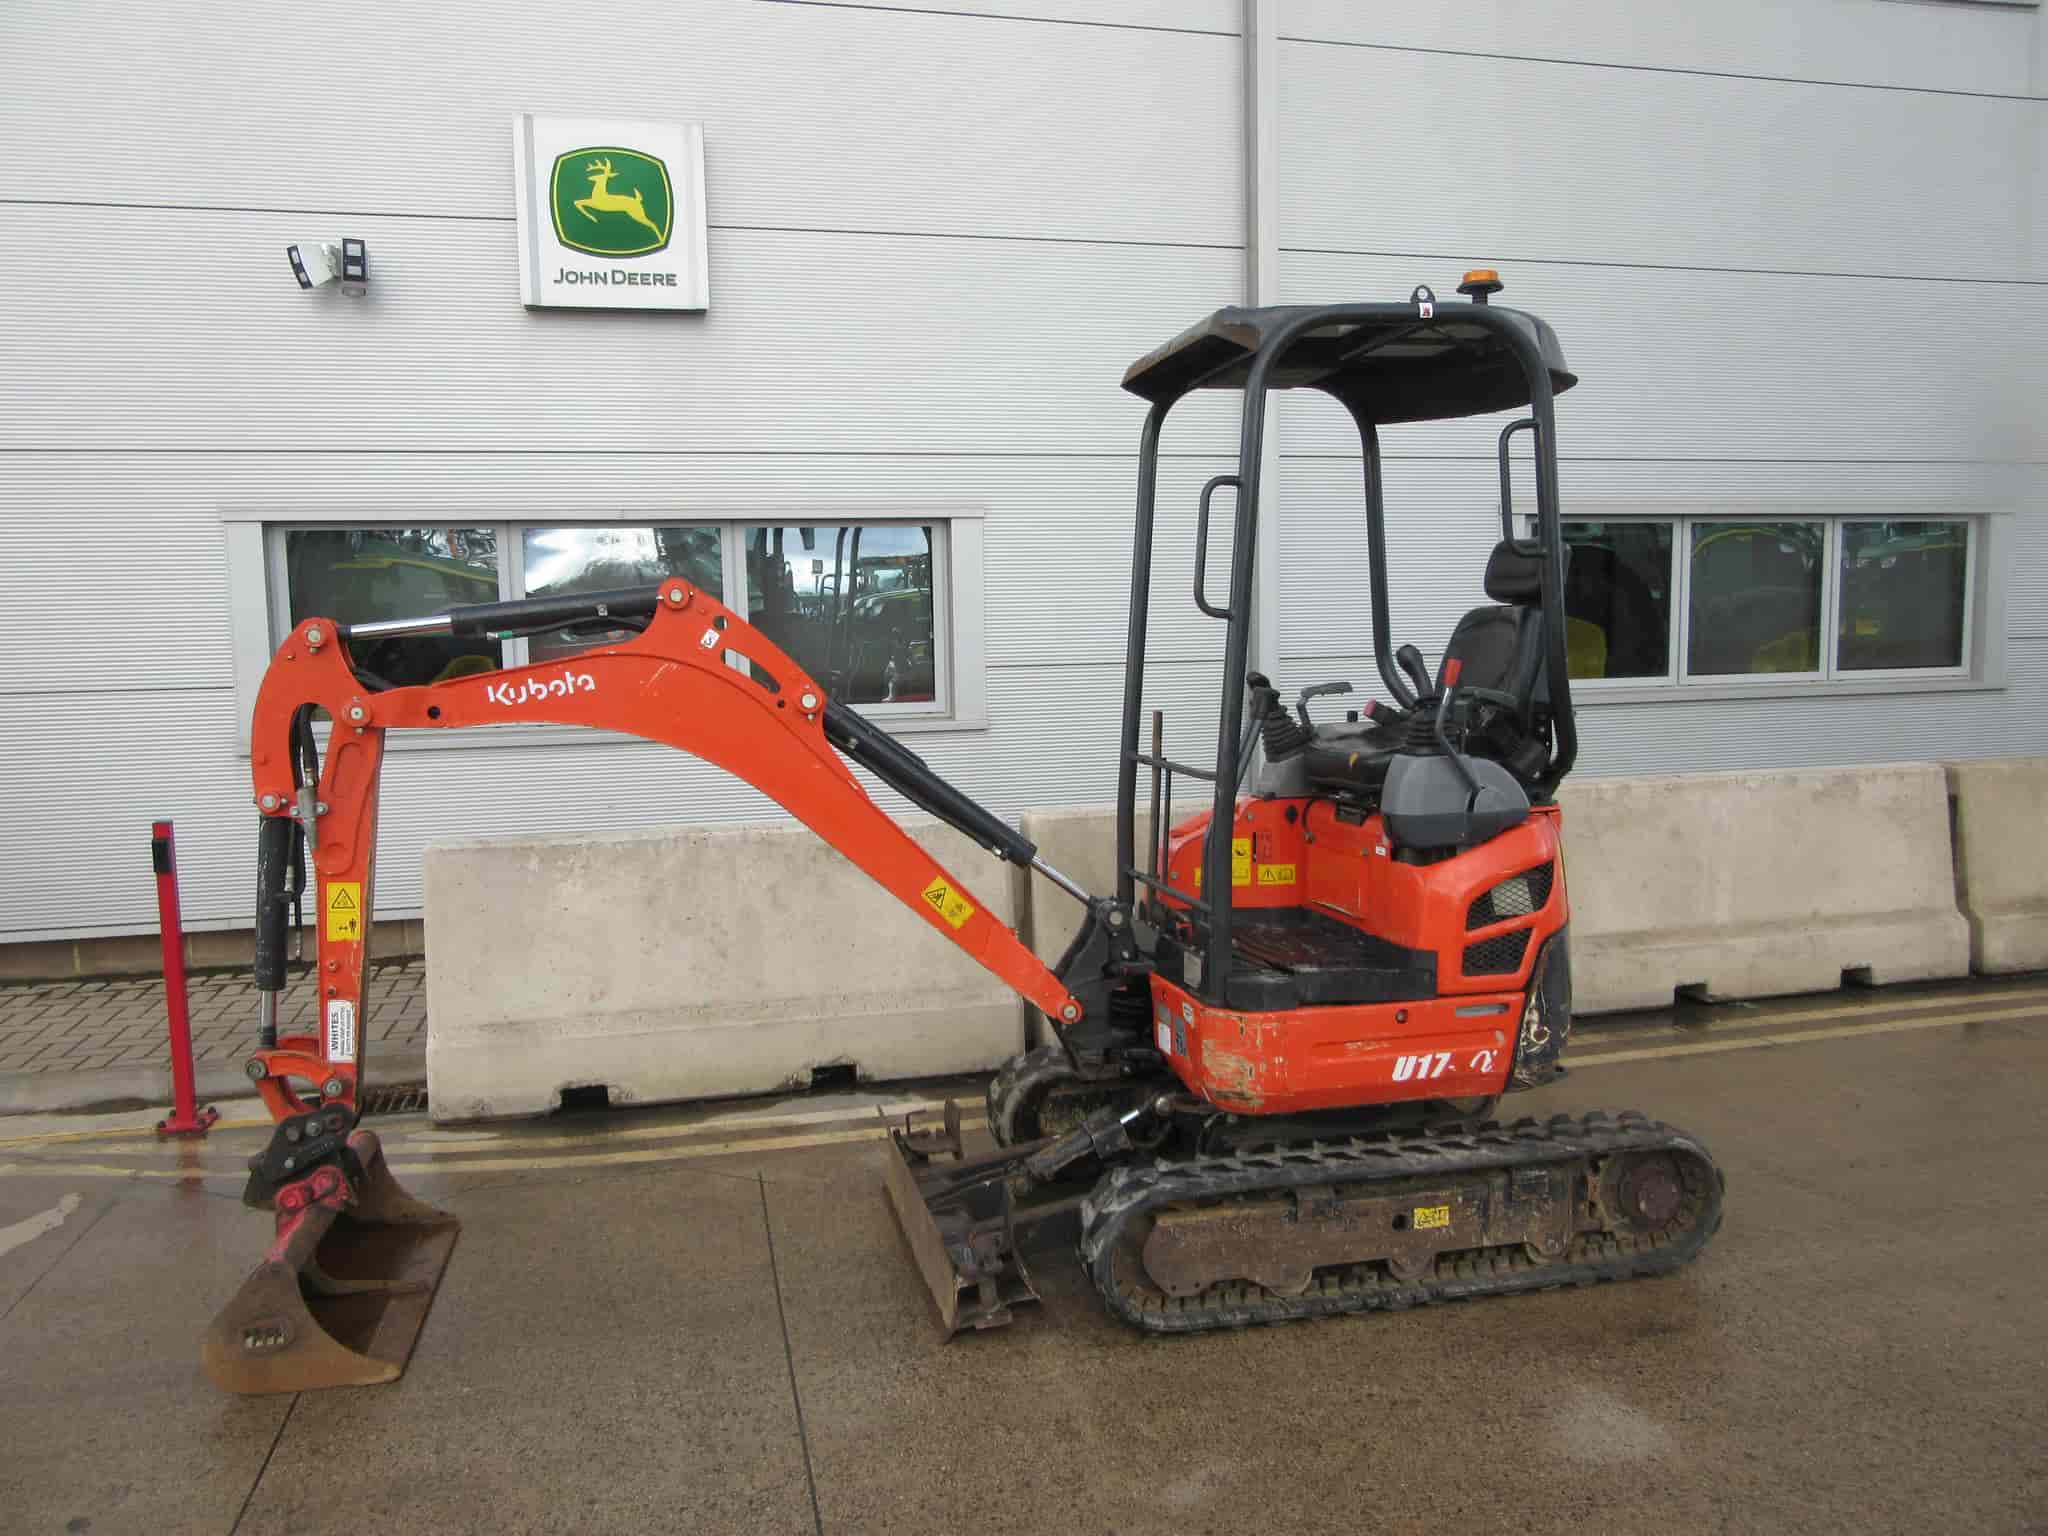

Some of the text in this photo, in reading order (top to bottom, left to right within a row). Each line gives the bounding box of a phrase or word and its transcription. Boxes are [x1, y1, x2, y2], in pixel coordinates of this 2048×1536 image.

[553, 267, 677, 286] JOHN DEERE
[487, 671, 595, 706] Kubota
[331, 1011, 339, 1051] WHITES
